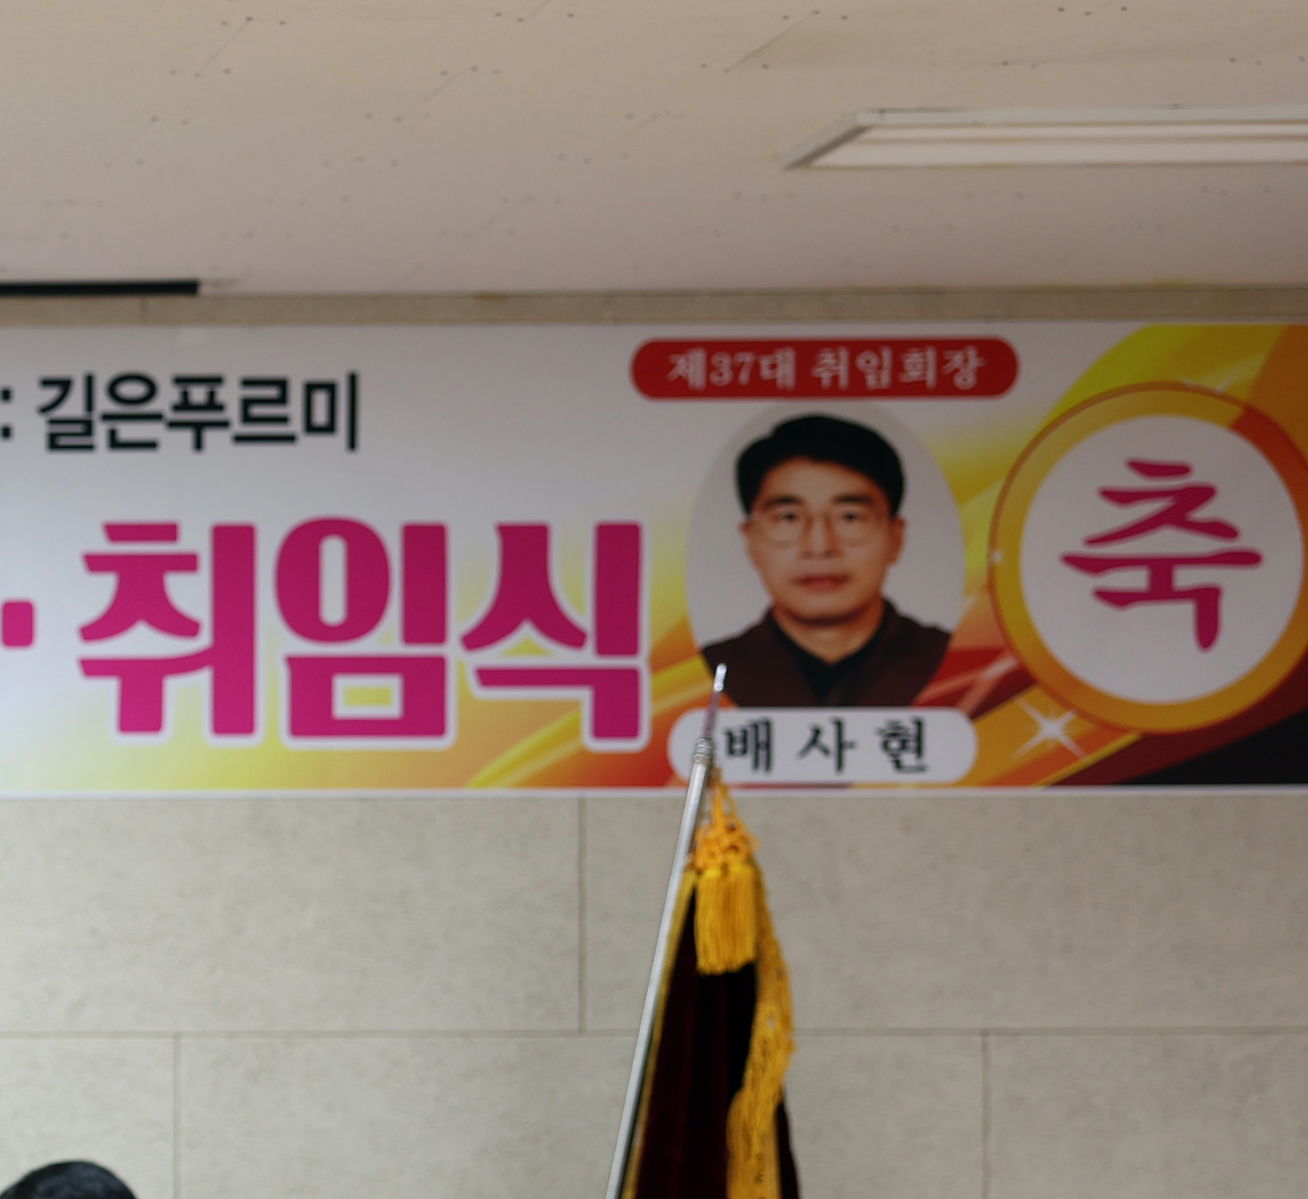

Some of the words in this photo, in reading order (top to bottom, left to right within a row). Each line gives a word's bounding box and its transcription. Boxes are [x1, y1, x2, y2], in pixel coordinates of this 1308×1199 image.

[666, 346, 797, 391] 제37대
[810, 345, 985, 391] 취임회장
[37, 371, 360, 452] 길은푸르미
[1061, 458, 1263, 652] 축
